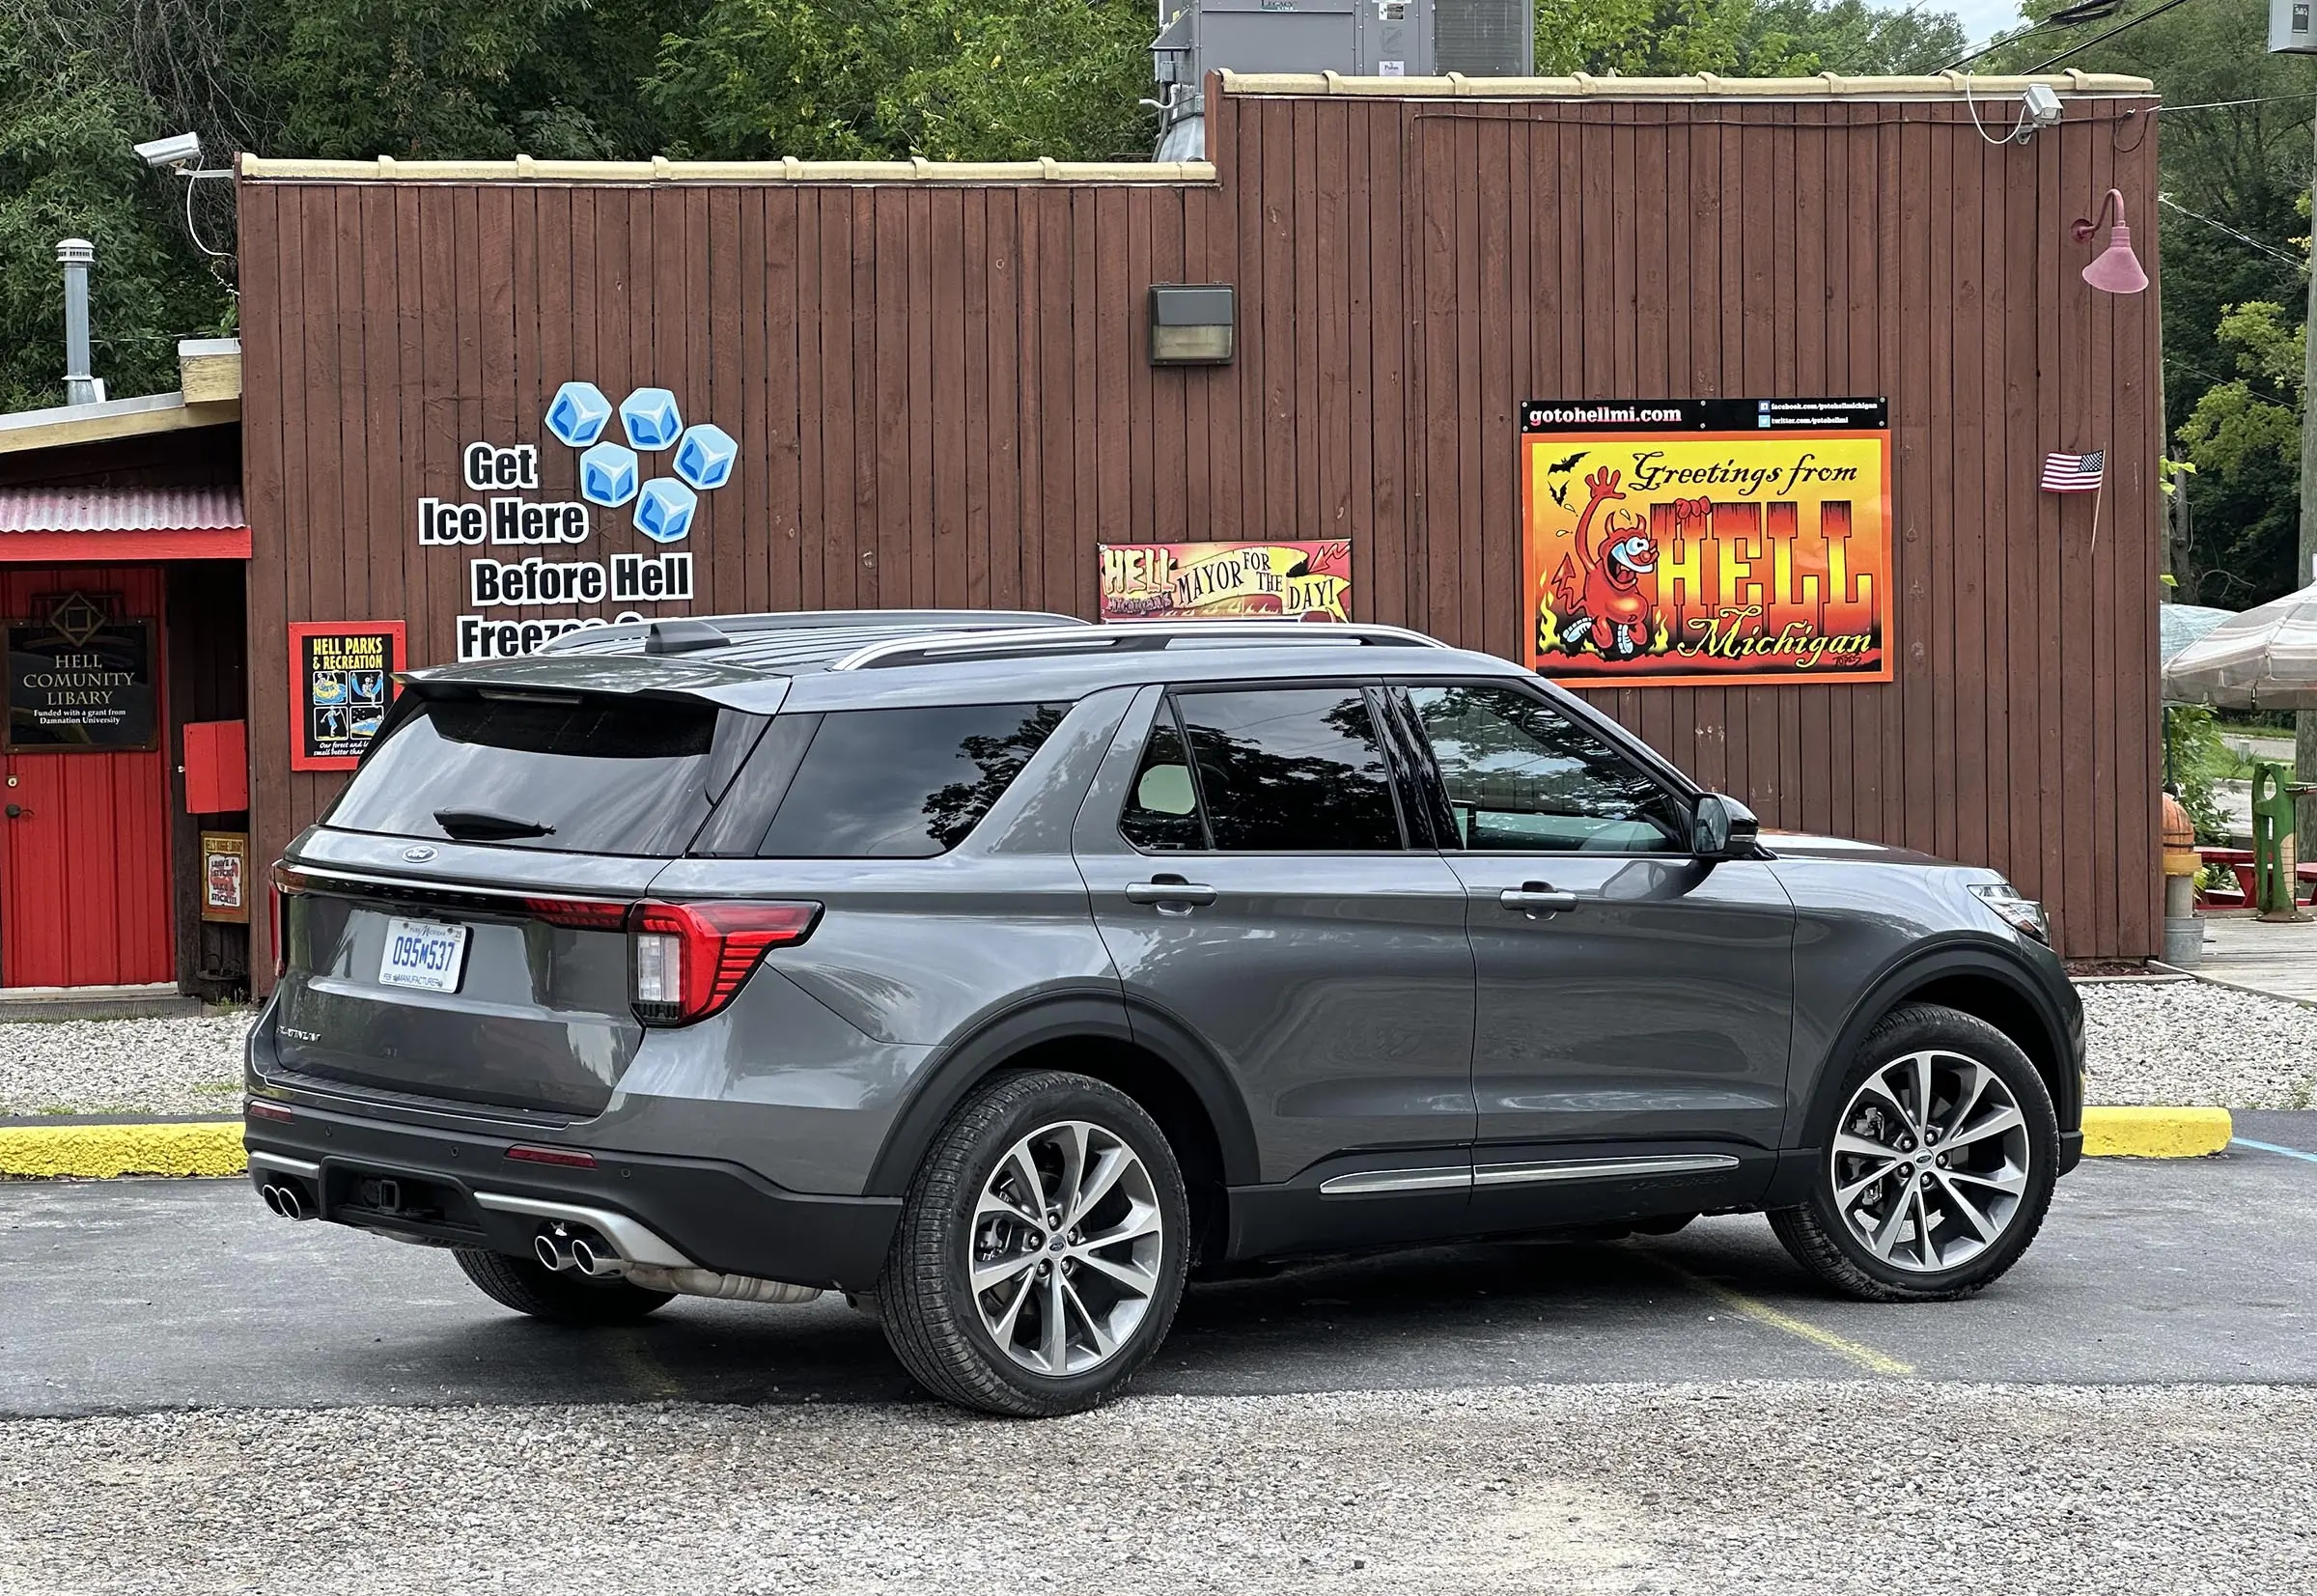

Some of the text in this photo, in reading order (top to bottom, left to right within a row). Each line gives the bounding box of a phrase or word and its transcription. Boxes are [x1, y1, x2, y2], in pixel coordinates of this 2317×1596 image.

[1529, 406, 1682, 427] gotohellmi.com
[467, 444, 537, 486] Get
[1629, 451, 1858, 496] Greetings from
[422, 500, 585, 541] Ice Here
[475, 556, 689, 602] Before Hell
[1103, 547, 1176, 595] HELL
[1177, 551, 1334, 610] MAYOR FOR THE DAY!
[1650, 499, 1873, 639] HELL
[313, 636, 383, 656] HELL PARKS
[1677, 605, 1871, 668] Michigan
[23, 672, 135, 687] COMUNITY
[54, 654, 102, 669] HELL
[313, 655, 383, 670] & RECREATION
[46, 690, 114, 706] LIBARY
[82, 716, 121, 725] University
[392, 936, 456, 971] 095M537
